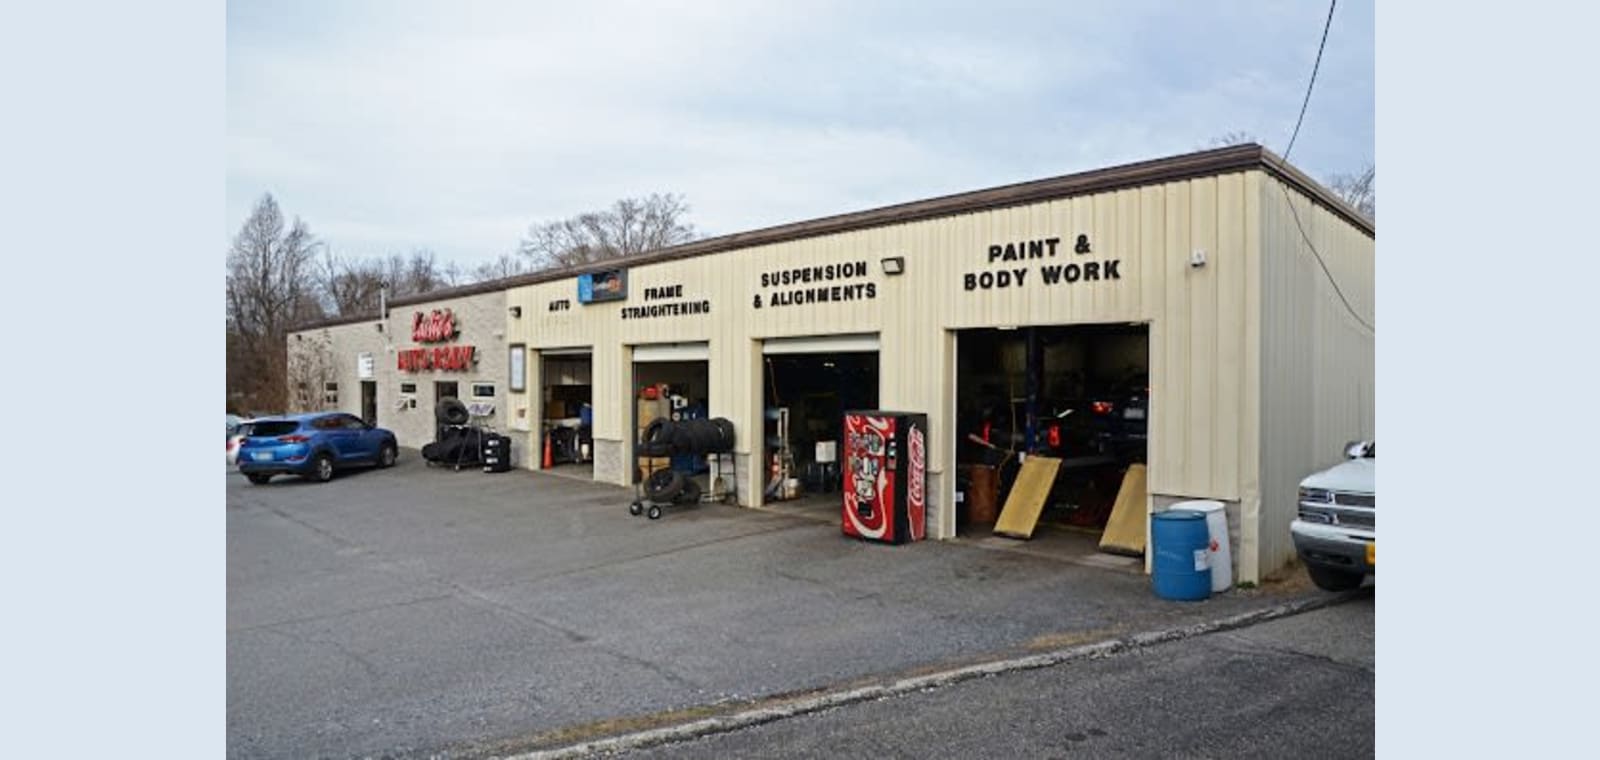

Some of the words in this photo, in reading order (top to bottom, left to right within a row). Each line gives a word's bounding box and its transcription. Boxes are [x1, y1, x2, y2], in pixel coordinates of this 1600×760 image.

[988, 237, 1060, 263] PAINT
[1074, 234, 1091, 255] &
[761, 260, 867, 288] SUSPENSION
[964, 267, 1028, 291] BODY
[1040, 259, 1121, 285] WORK
[549, 299, 570, 312] AUTO
[644, 285, 683, 301] FRAME
[753, 294, 763, 309] &
[770, 282, 876, 307] ALIGNMENTS
[621, 300, 710, 319] STRAIGHTENING
